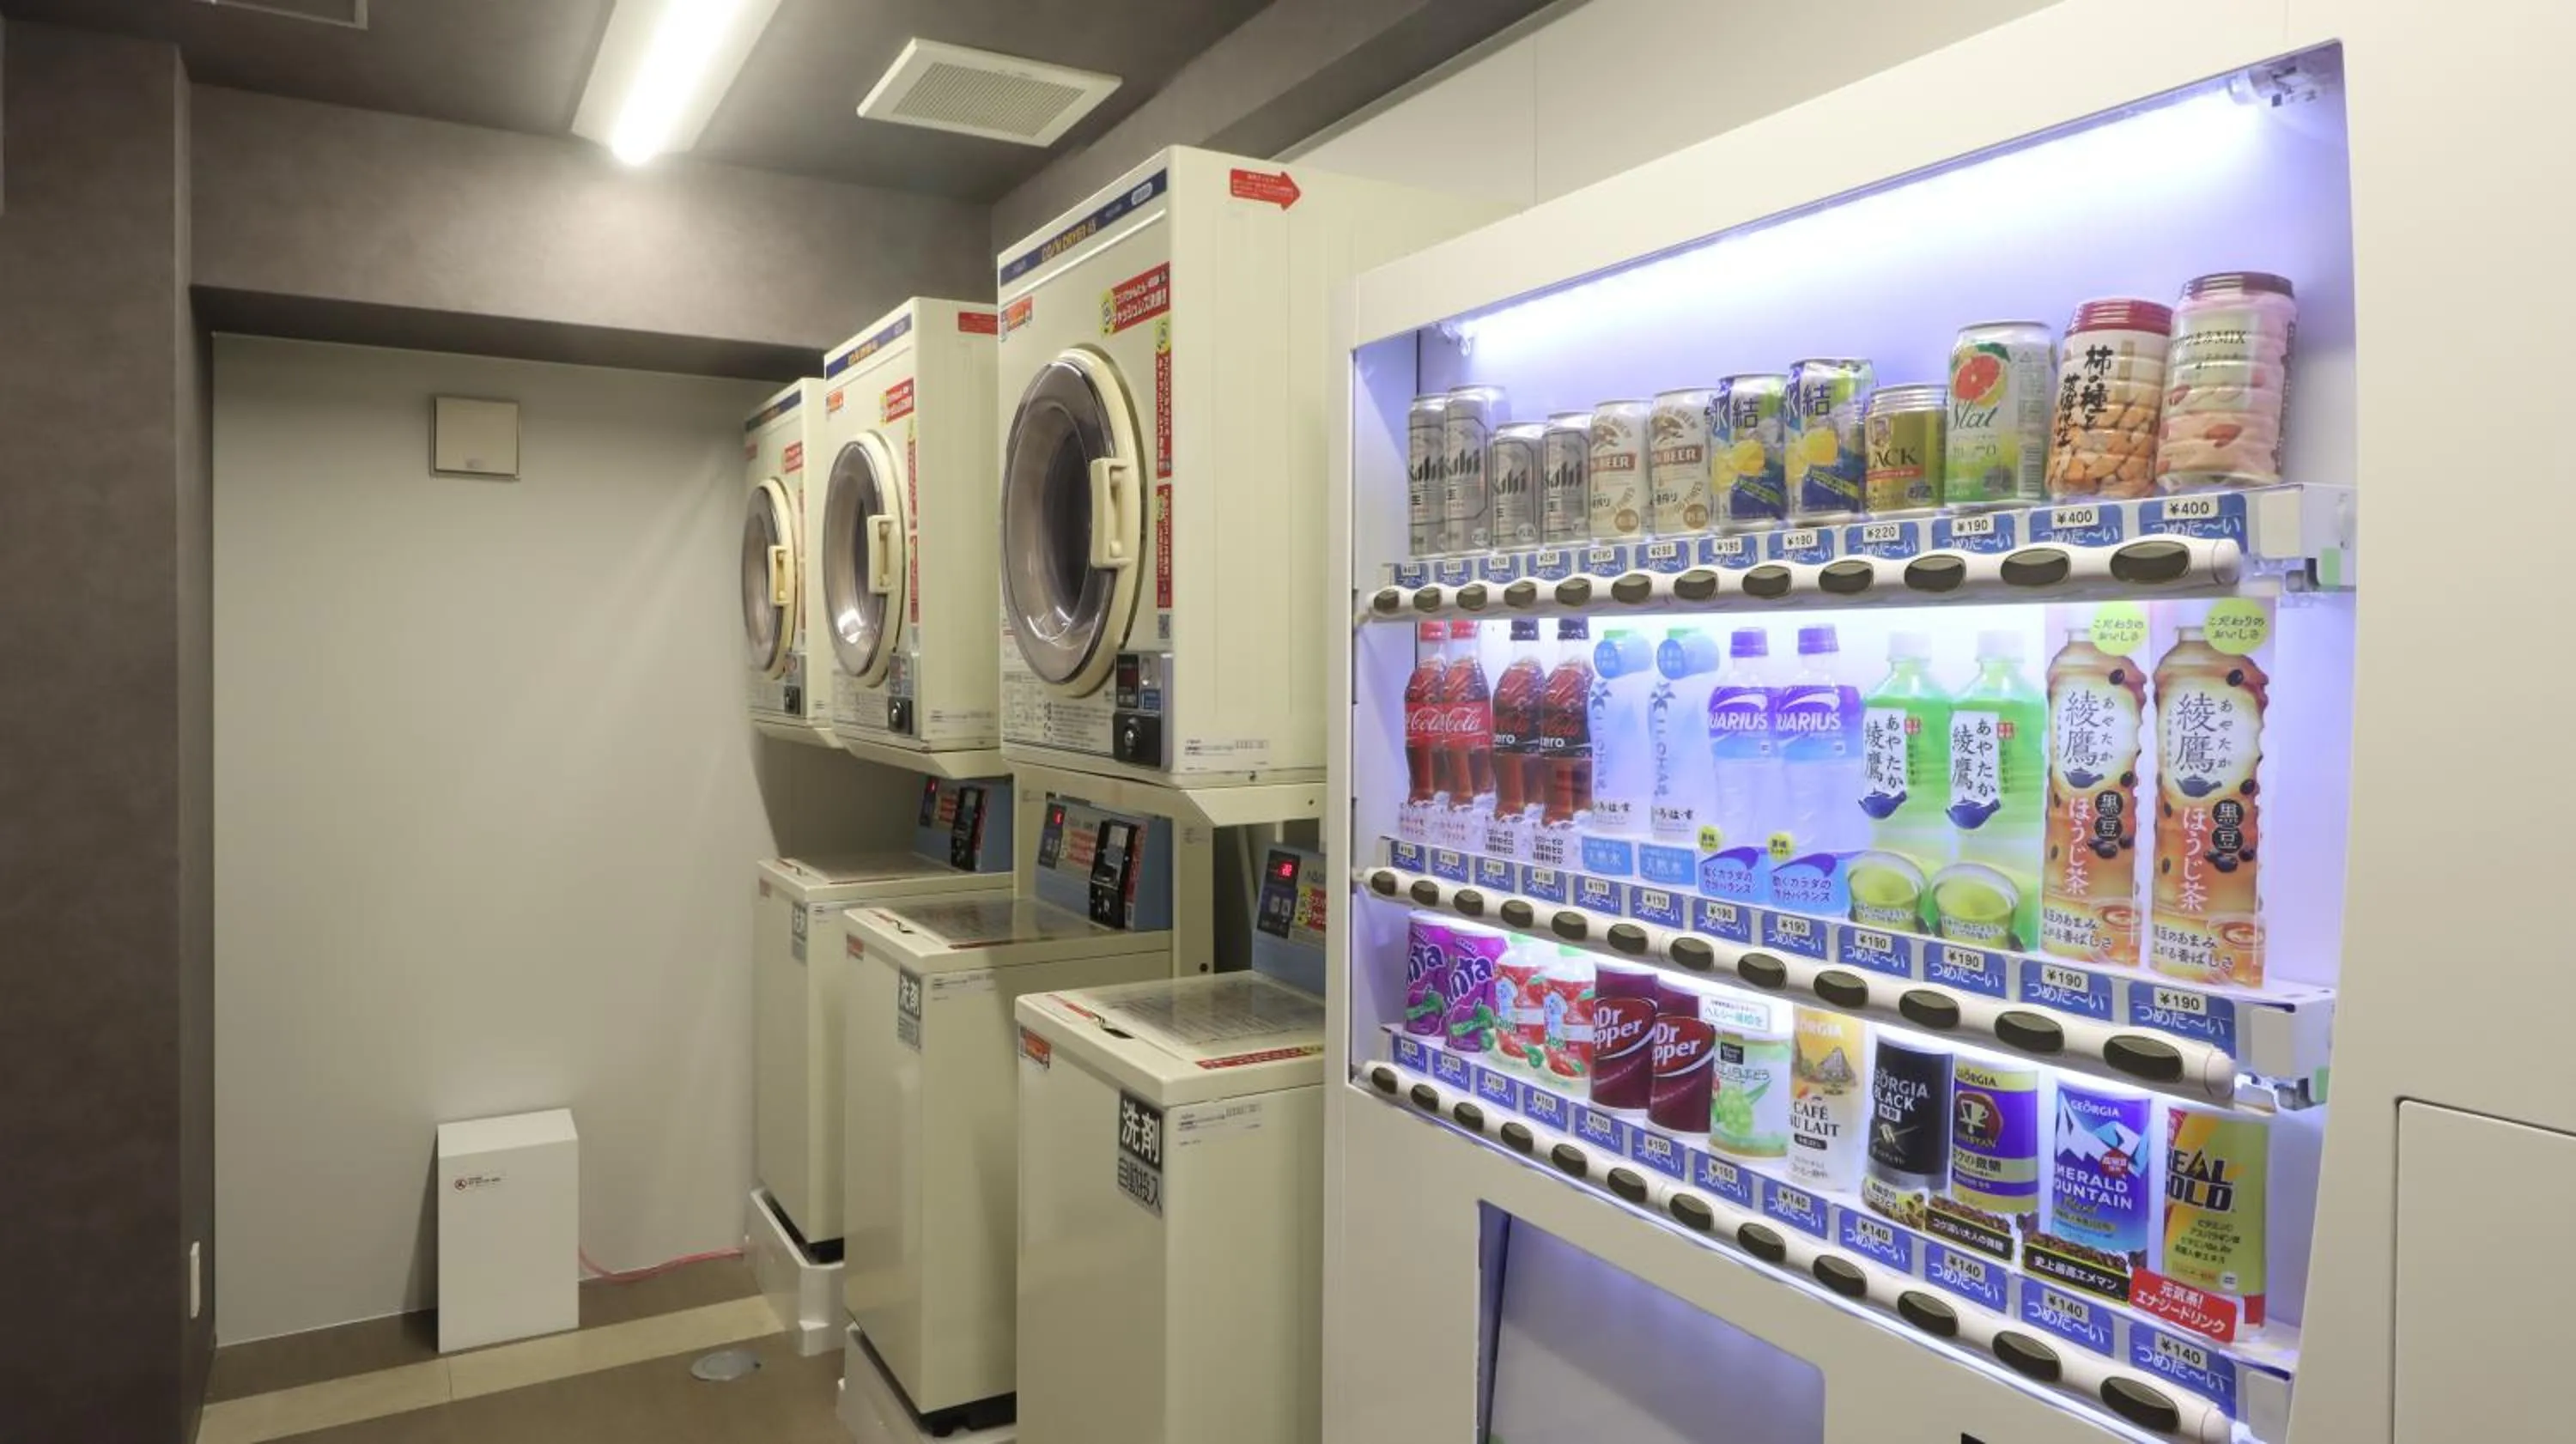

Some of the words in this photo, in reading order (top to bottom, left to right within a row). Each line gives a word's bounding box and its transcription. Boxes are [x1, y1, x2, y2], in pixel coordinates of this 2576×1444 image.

[2057, 509, 2093, 525] ¥400
[2170, 501, 2210, 515] ¥400
[1957, 519, 1989, 532] ¥190
[2093, 618, 2145, 631] こだわりの
[2208, 615, 2266, 628] こだわりの
[2212, 628, 2260, 641] おいしさ
[2063, 689, 2101, 767] 綾鷹
[2100, 696, 2115, 763] あやたか
[2176, 692, 2219, 774] 綾鷹
[2218, 699, 2233, 769] あやたか
[1886, 713, 1904, 789] あやたか
[1952, 723, 1976, 791] 綾鷹
[1977, 718, 1996, 798] あやたか
[2102, 793, 2121, 839] 黒豆
[2218, 802, 2239, 850] 黒豆
[2066, 796, 2089, 895] ほうじ茶
[2181, 807, 2208, 913] ほうじ茶
[1947, 952, 1980, 968] ¥190
[2046, 971, 2082, 988] ¥190
[2160, 992, 2201, 1011] ¥190
[1598, 1005, 1625, 1028] Dr
[1656, 1022, 1680, 1045] Dr
[1121, 1099, 1160, 1164] 洗剤
[1804, 1119, 1841, 1138] LAIT
[1860, 1221, 1889, 1241] ¥140
[1948, 1254, 1983, 1277] ¥140
[2047, 1295, 2084, 1318] ¥140
[2136, 1291, 2227, 1333] エナジードリンク
[2160, 1337, 2202, 1365] ¥140
